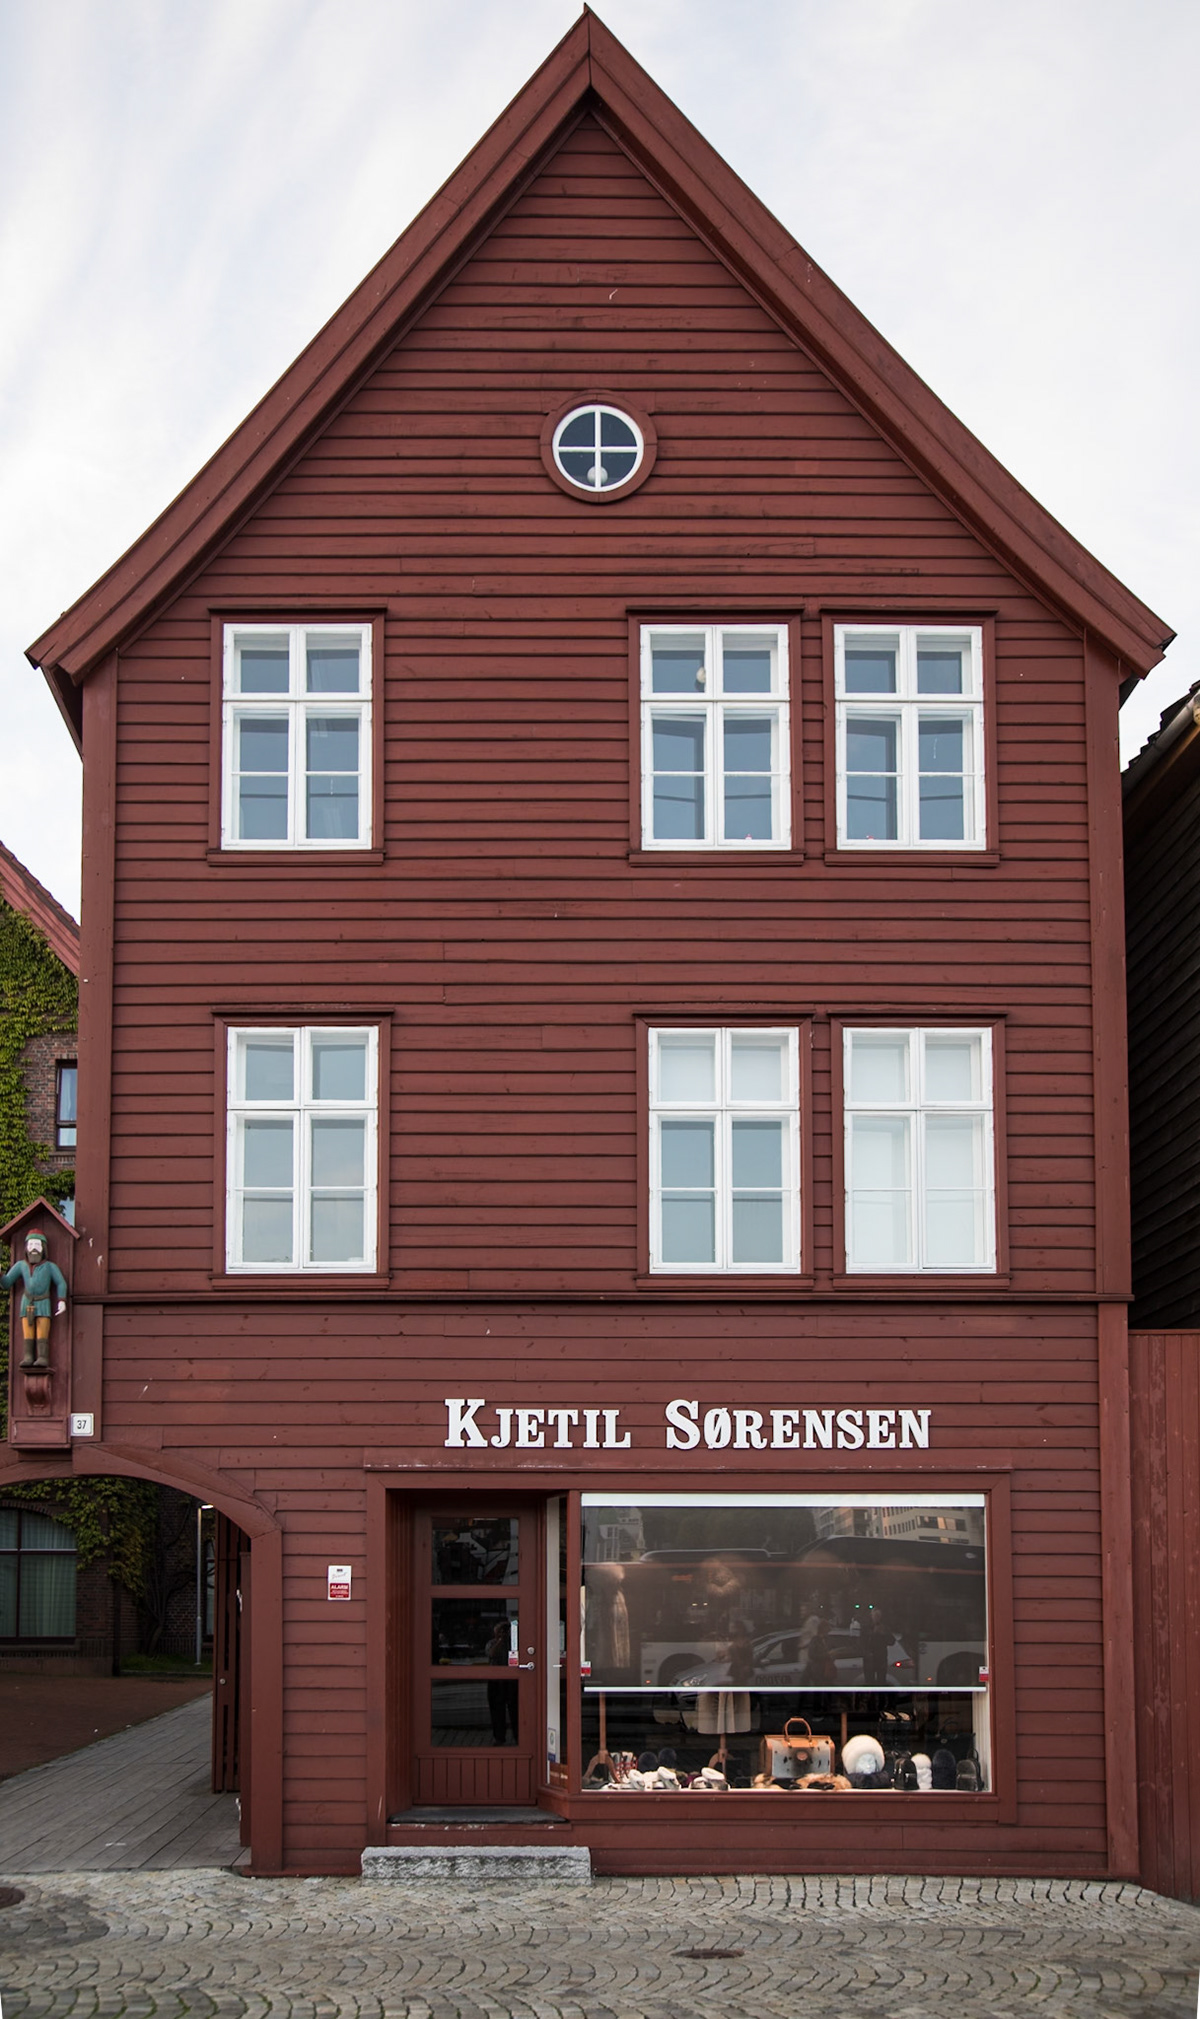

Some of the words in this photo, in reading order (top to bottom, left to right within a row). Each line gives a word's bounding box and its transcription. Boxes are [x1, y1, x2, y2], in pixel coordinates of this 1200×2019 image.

[77, 1419, 87, 1430] 37
[444, 1398, 632, 1448] KJETIL
[664, 1398, 932, 1449] SØRENSEN
